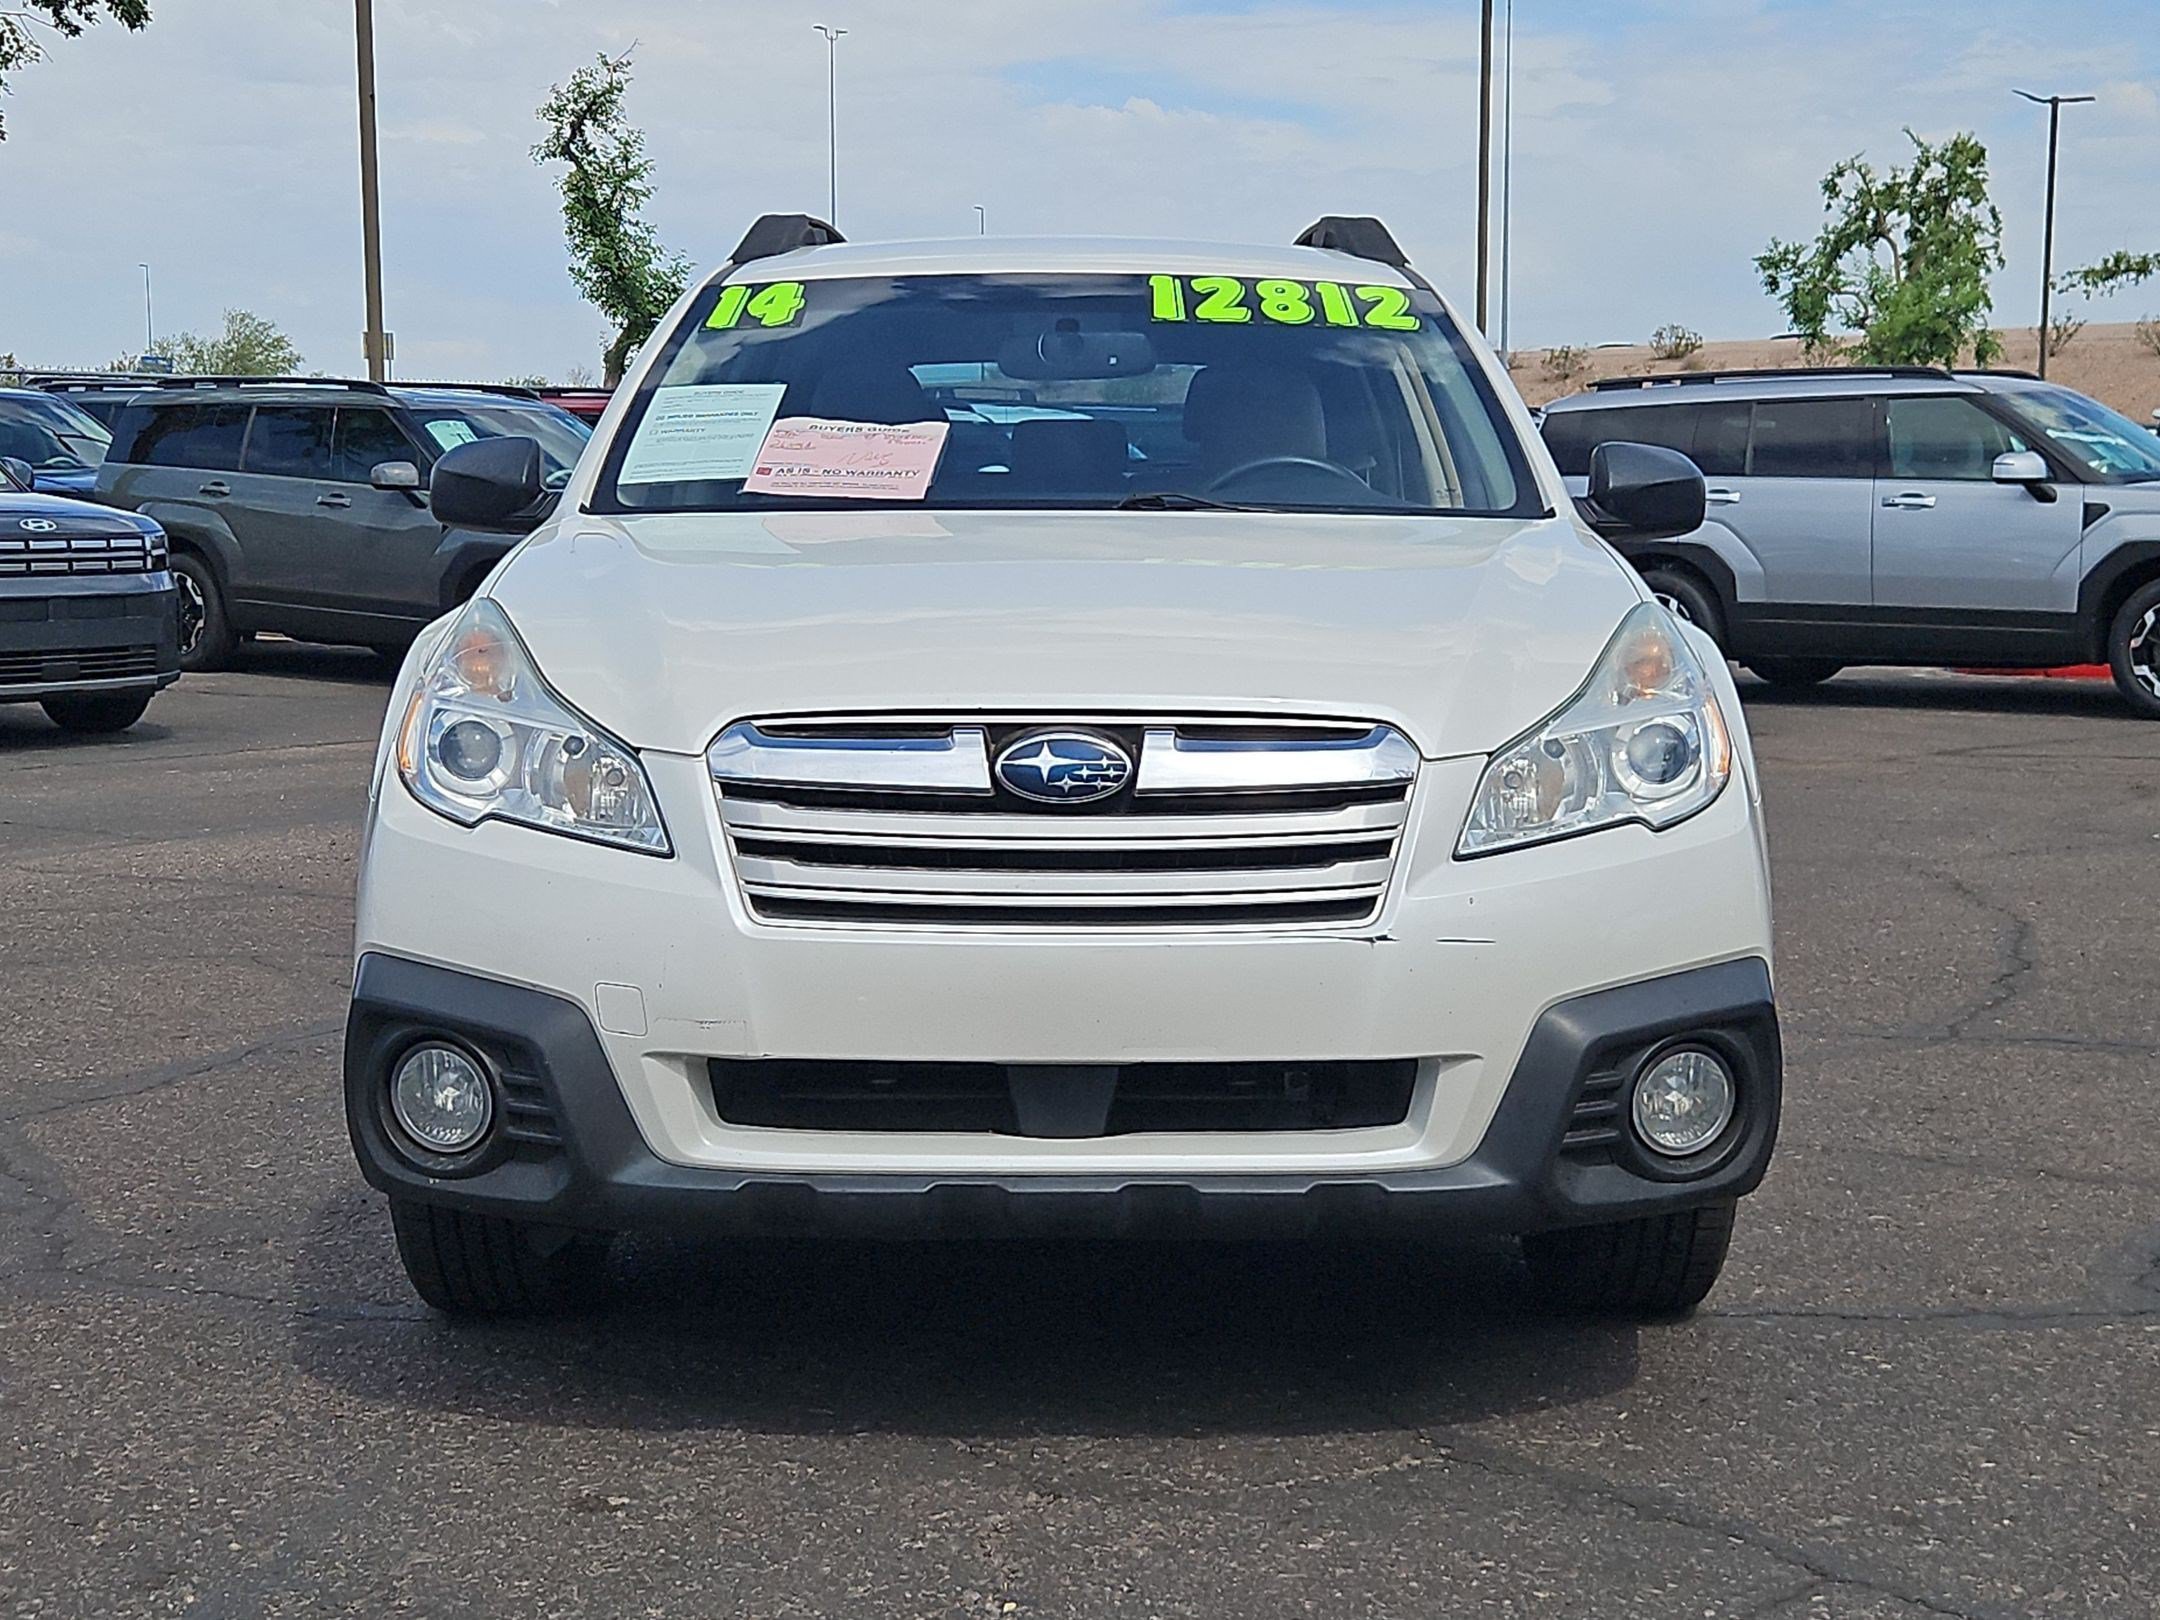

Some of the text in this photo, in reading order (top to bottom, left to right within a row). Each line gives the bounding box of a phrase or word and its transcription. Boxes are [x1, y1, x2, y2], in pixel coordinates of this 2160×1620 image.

[705, 282, 806, 329] 14
[1149, 275, 1421, 331] 12812
[809, 424, 864, 433] BUYERS
